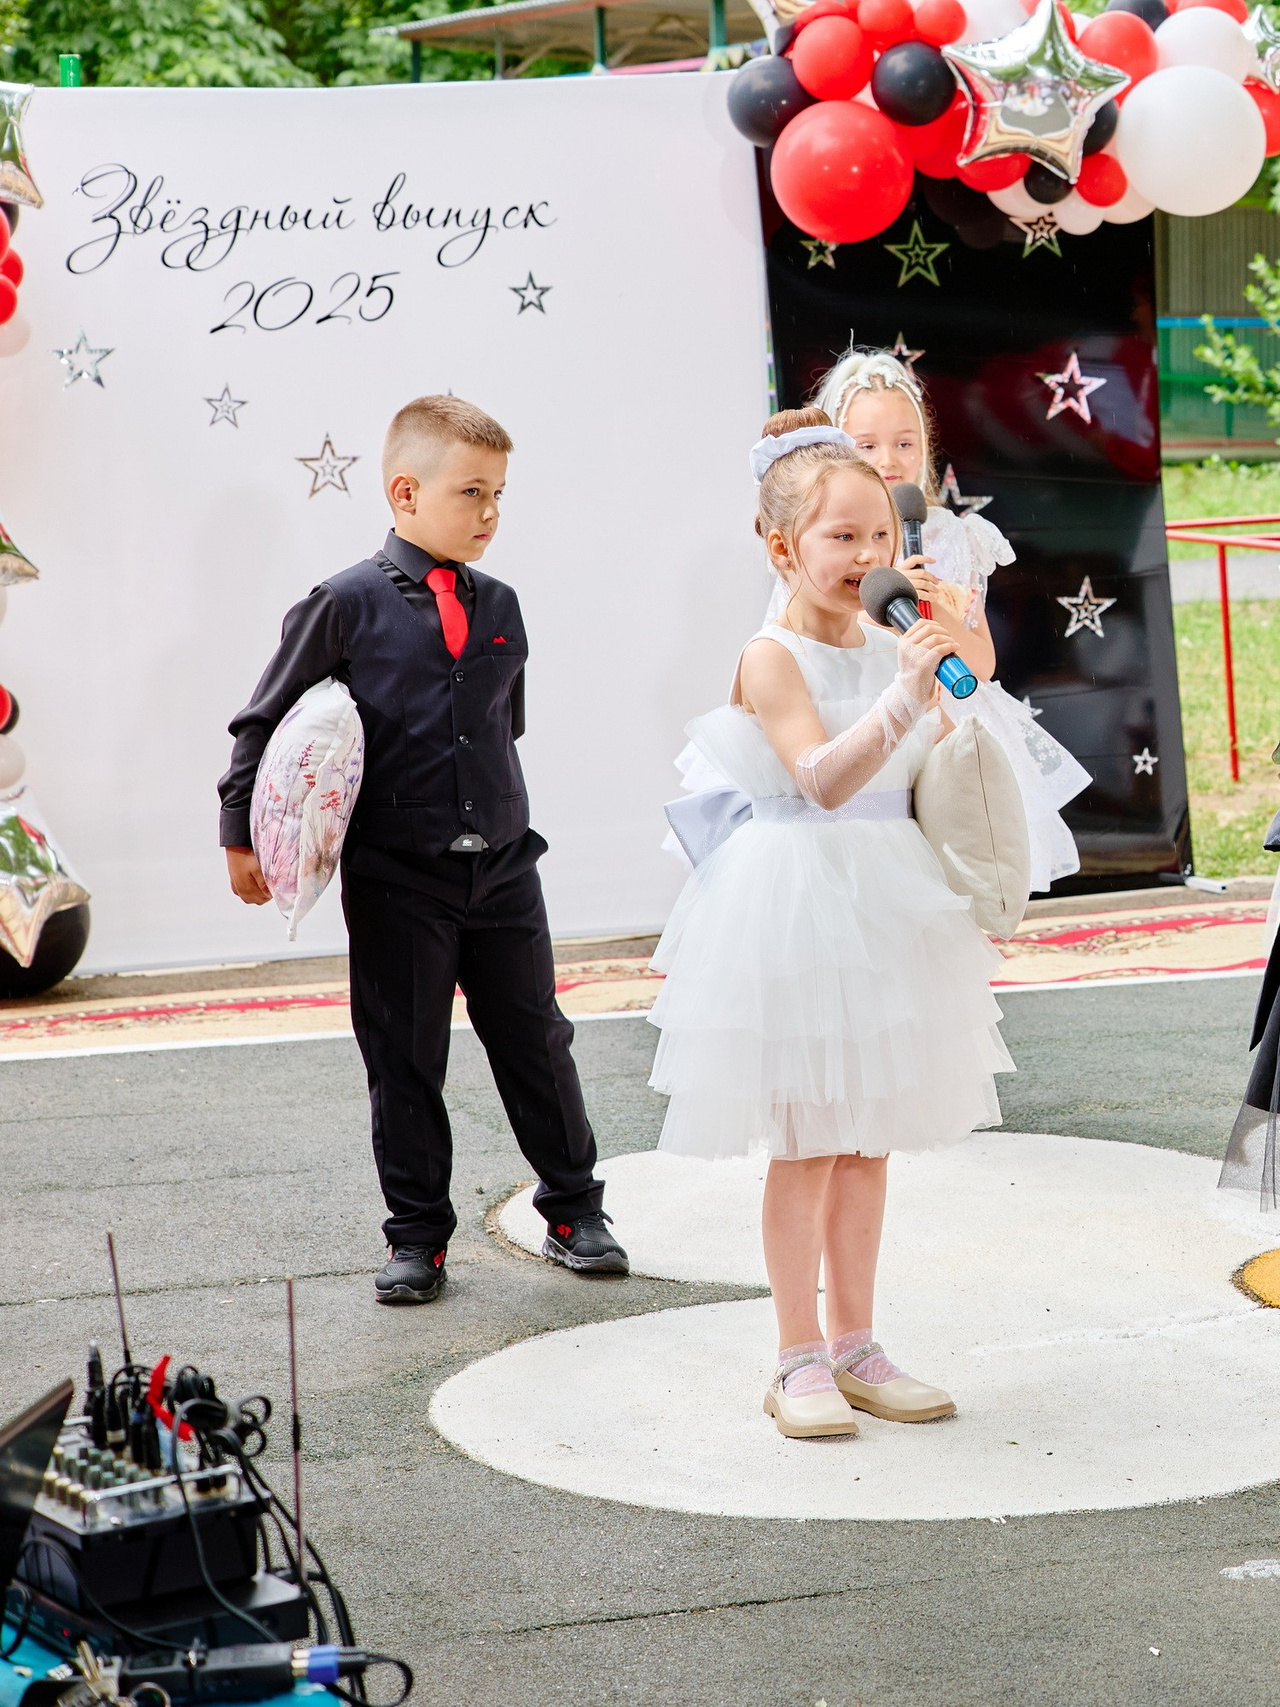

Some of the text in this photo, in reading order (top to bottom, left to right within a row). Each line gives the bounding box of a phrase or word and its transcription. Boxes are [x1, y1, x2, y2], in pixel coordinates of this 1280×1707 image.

[66, 162, 558, 274] Звёздный выпуск
[209, 271, 401, 334] 2025
